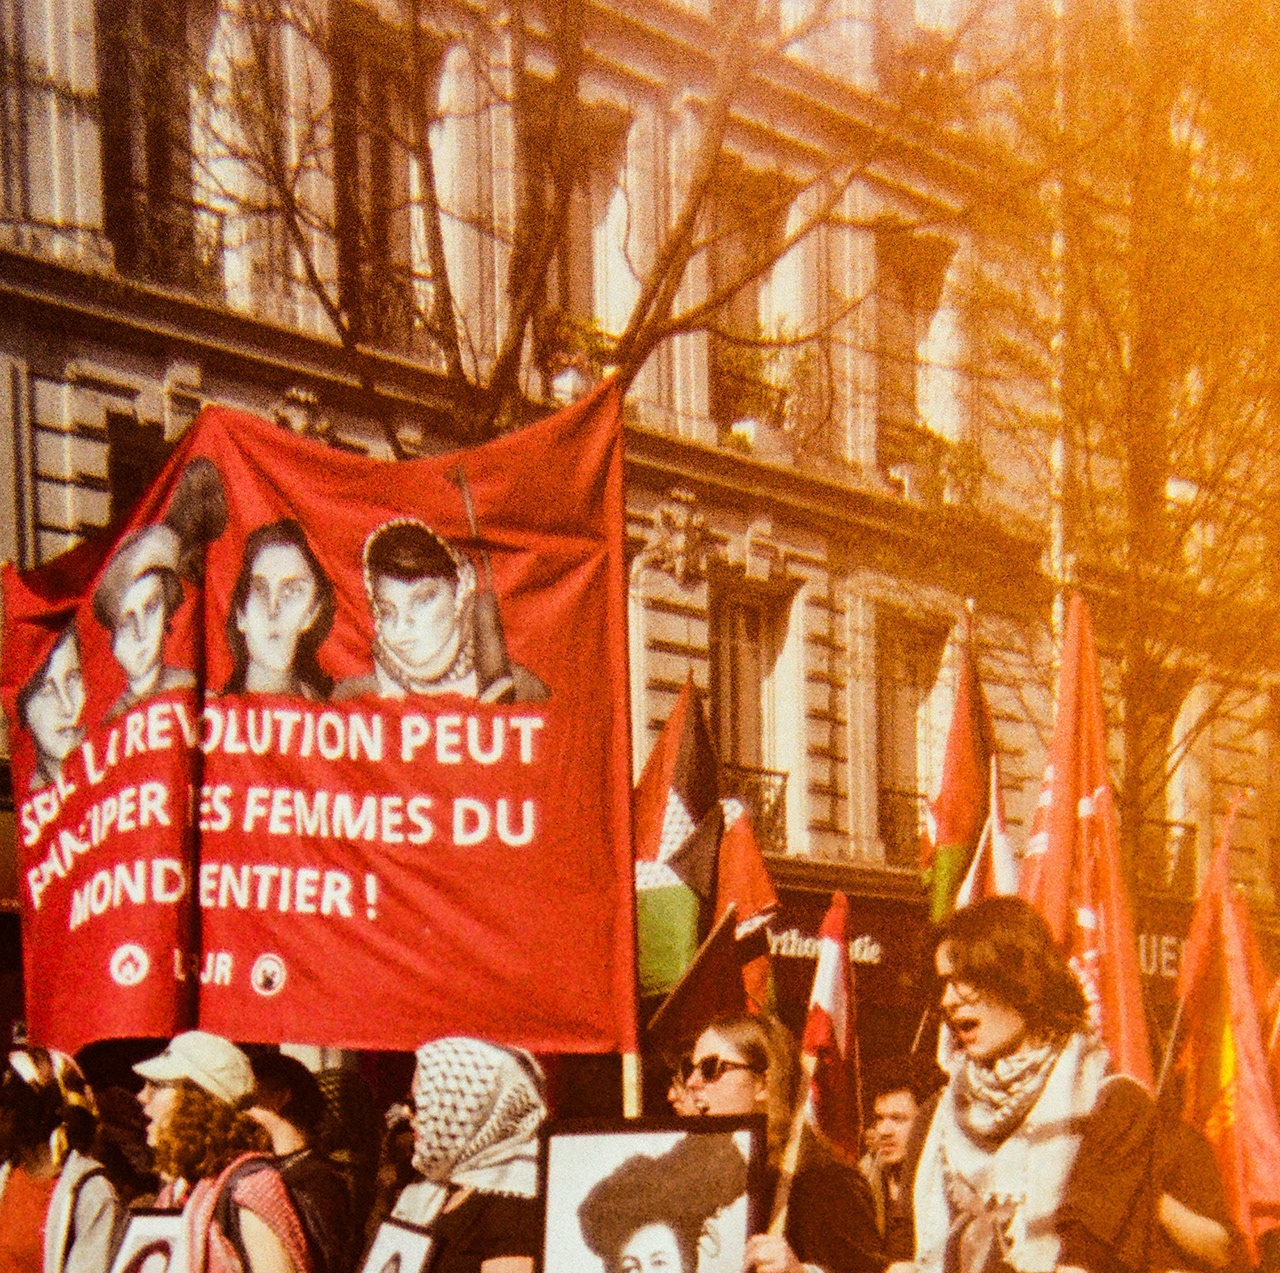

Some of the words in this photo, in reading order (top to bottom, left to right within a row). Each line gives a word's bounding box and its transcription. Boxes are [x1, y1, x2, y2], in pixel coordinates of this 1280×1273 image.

[401, 714, 544, 765] PEUT
[243, 786, 434, 845] FEMMES
[452, 797, 536, 847] DU
[70, 858, 190, 930] MOND
[200, 863, 353, 918] ENTIER
